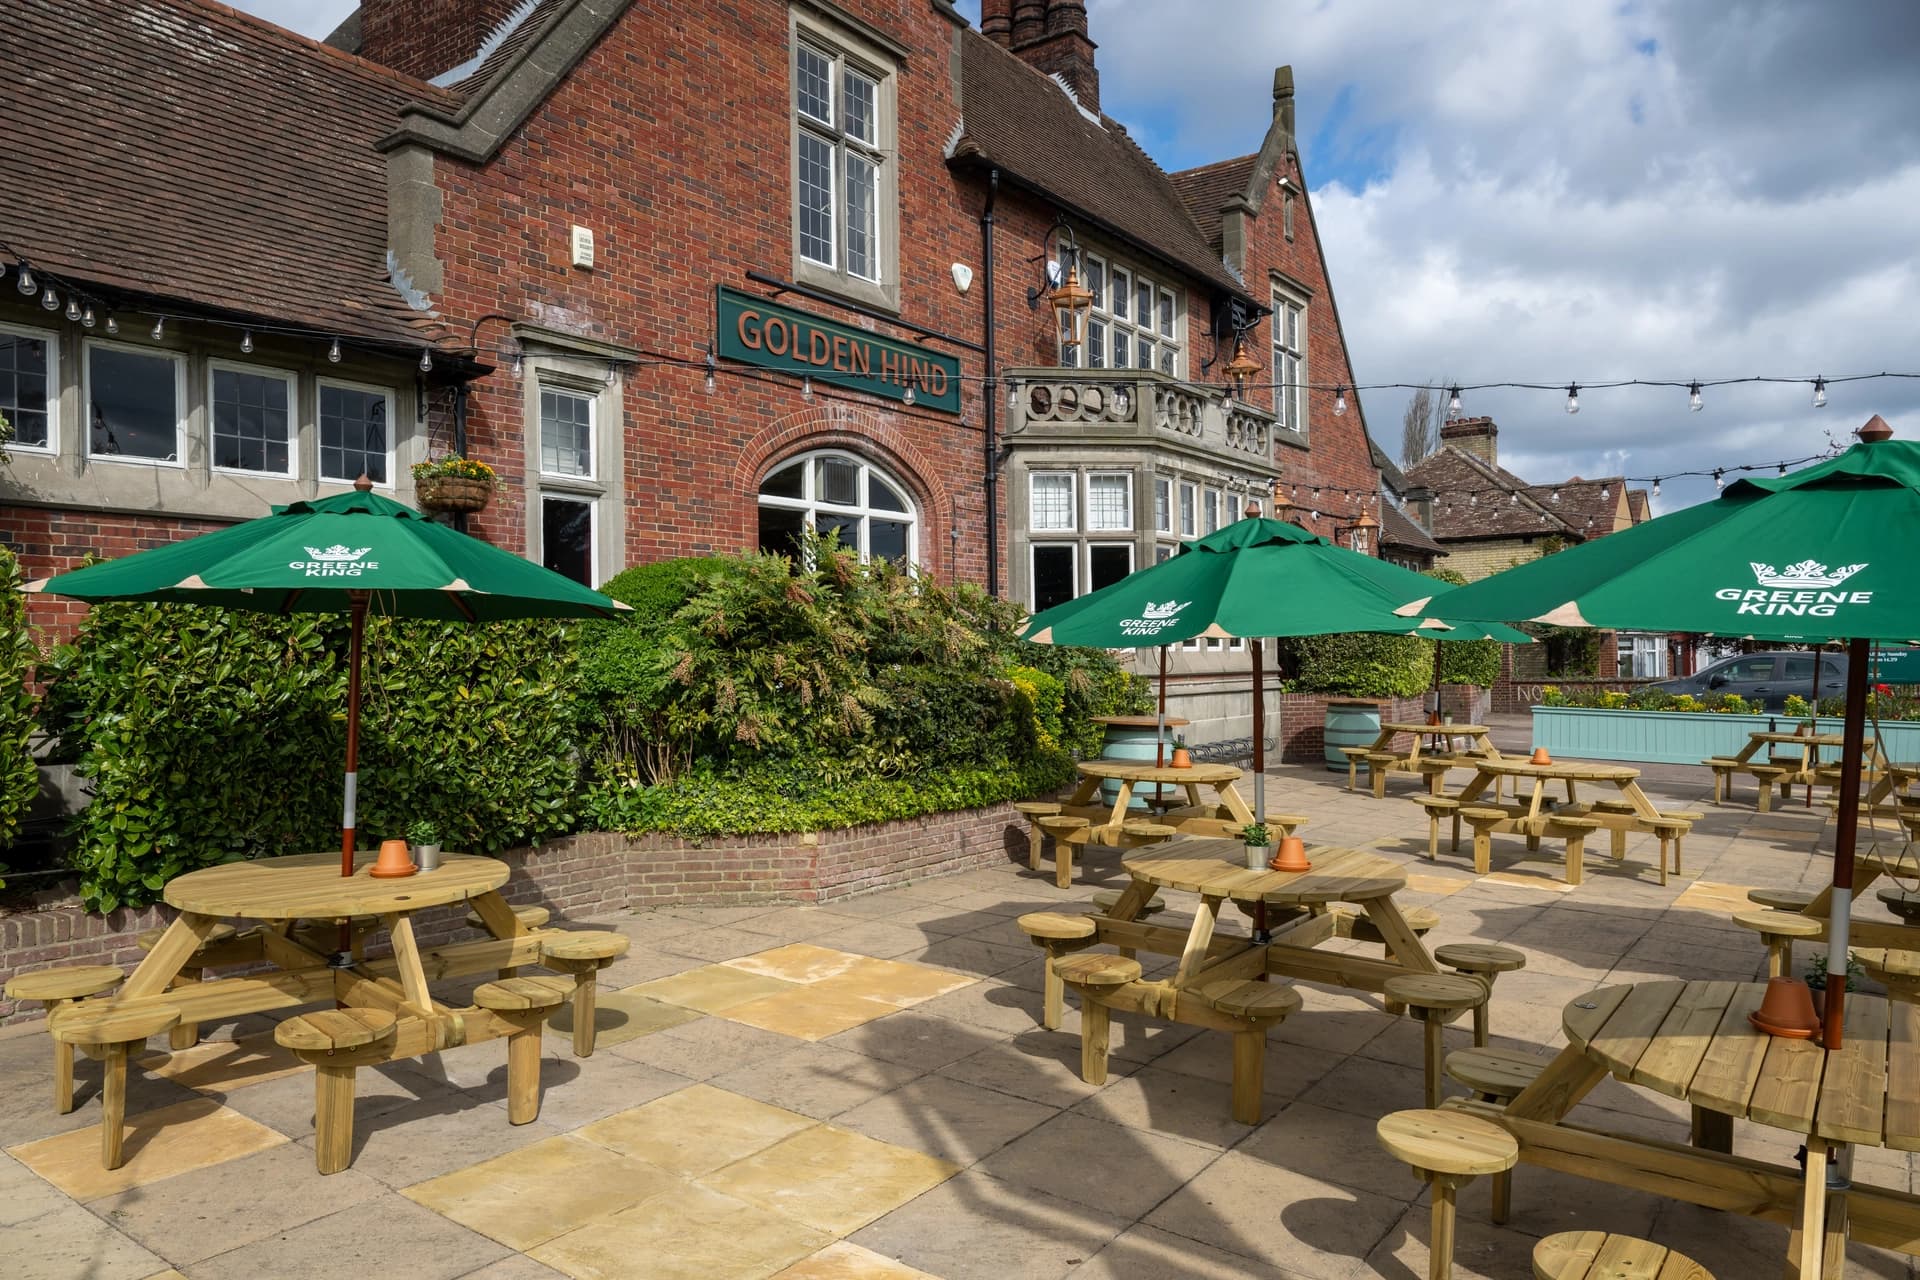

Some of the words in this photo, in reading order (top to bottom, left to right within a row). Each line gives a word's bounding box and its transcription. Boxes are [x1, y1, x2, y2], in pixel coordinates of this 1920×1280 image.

[738, 311, 871, 379] GOLDEN
[880, 350, 948, 397] HIND
[288, 561, 380, 570] GREENE
[305, 569, 362, 577] KING
[1715, 588, 1873, 604] GREENE
[1736, 602, 1838, 617] KING
[1119, 618, 1180, 628] GREENE
[1121, 627, 1162, 636] KING
[1517, 685, 1543, 701] NO
